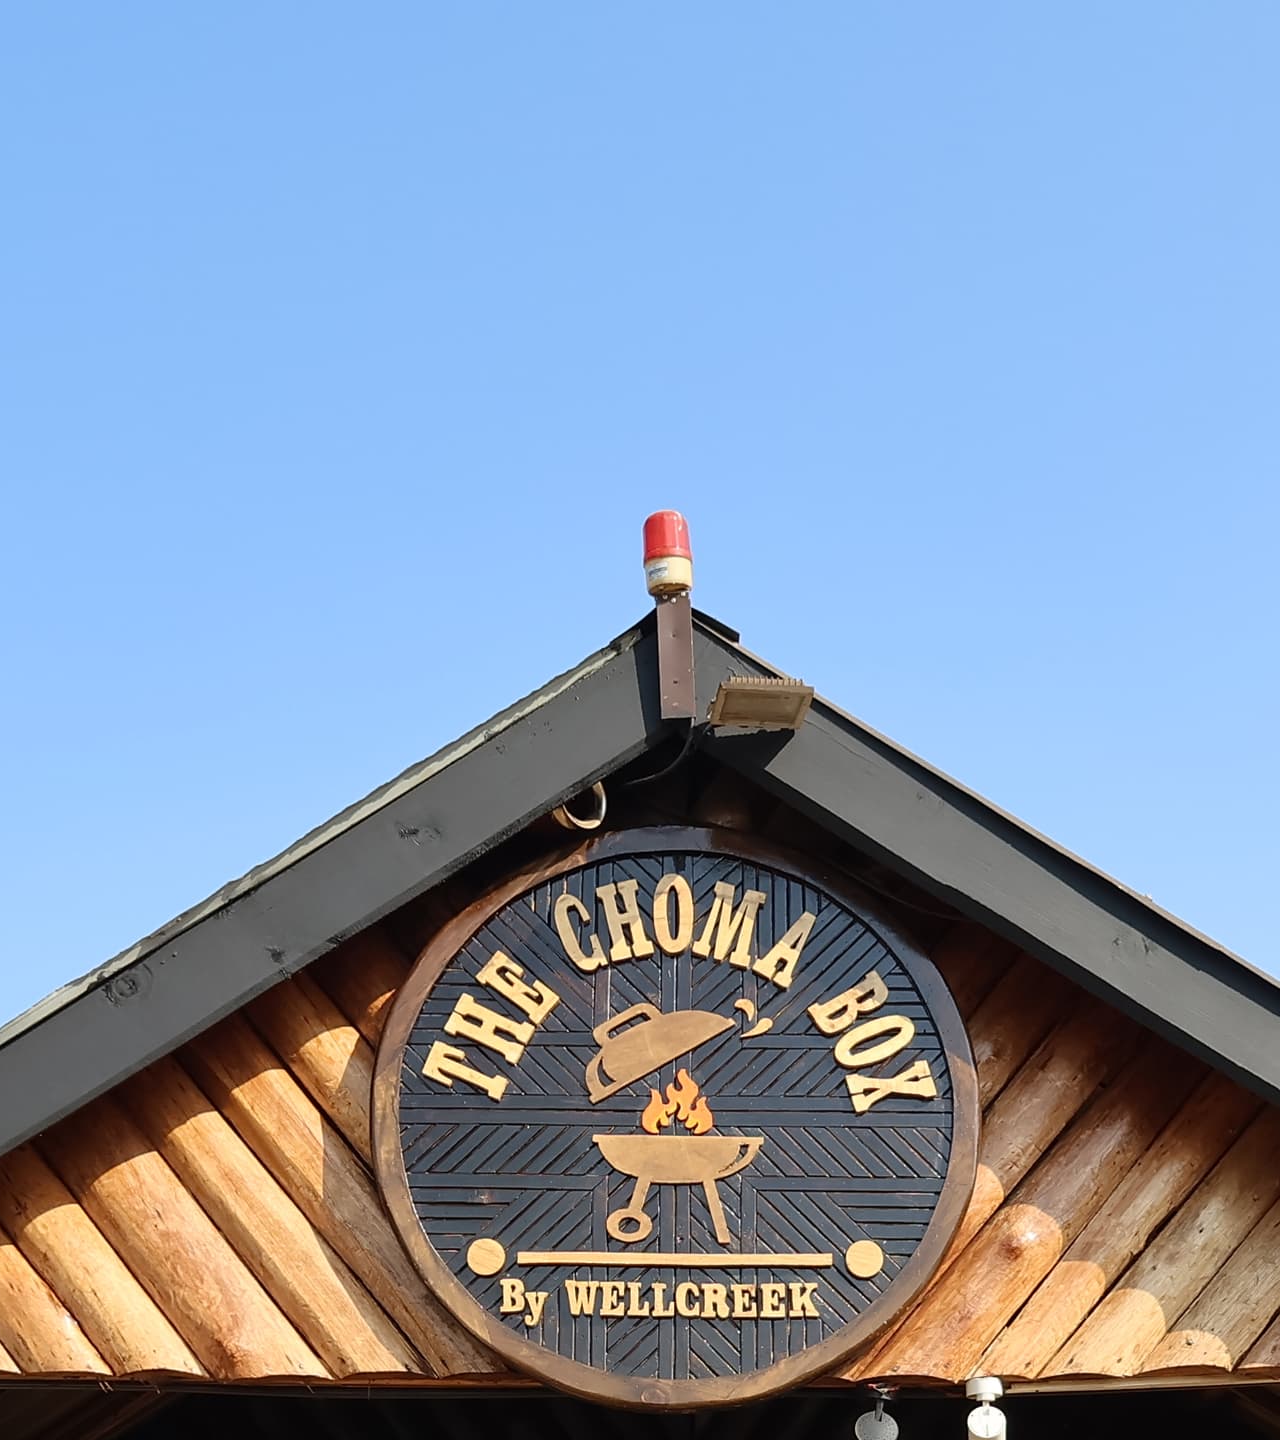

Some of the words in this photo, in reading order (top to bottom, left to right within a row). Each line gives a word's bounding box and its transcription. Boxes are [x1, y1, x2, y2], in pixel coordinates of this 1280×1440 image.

[422, 950, 560, 1101] THE
[553, 873, 817, 991] CHOMA
[807, 970, 937, 1113] BOX
[500, 1278, 549, 1326] By
[565, 1279, 820, 1318] WELLCREEK
